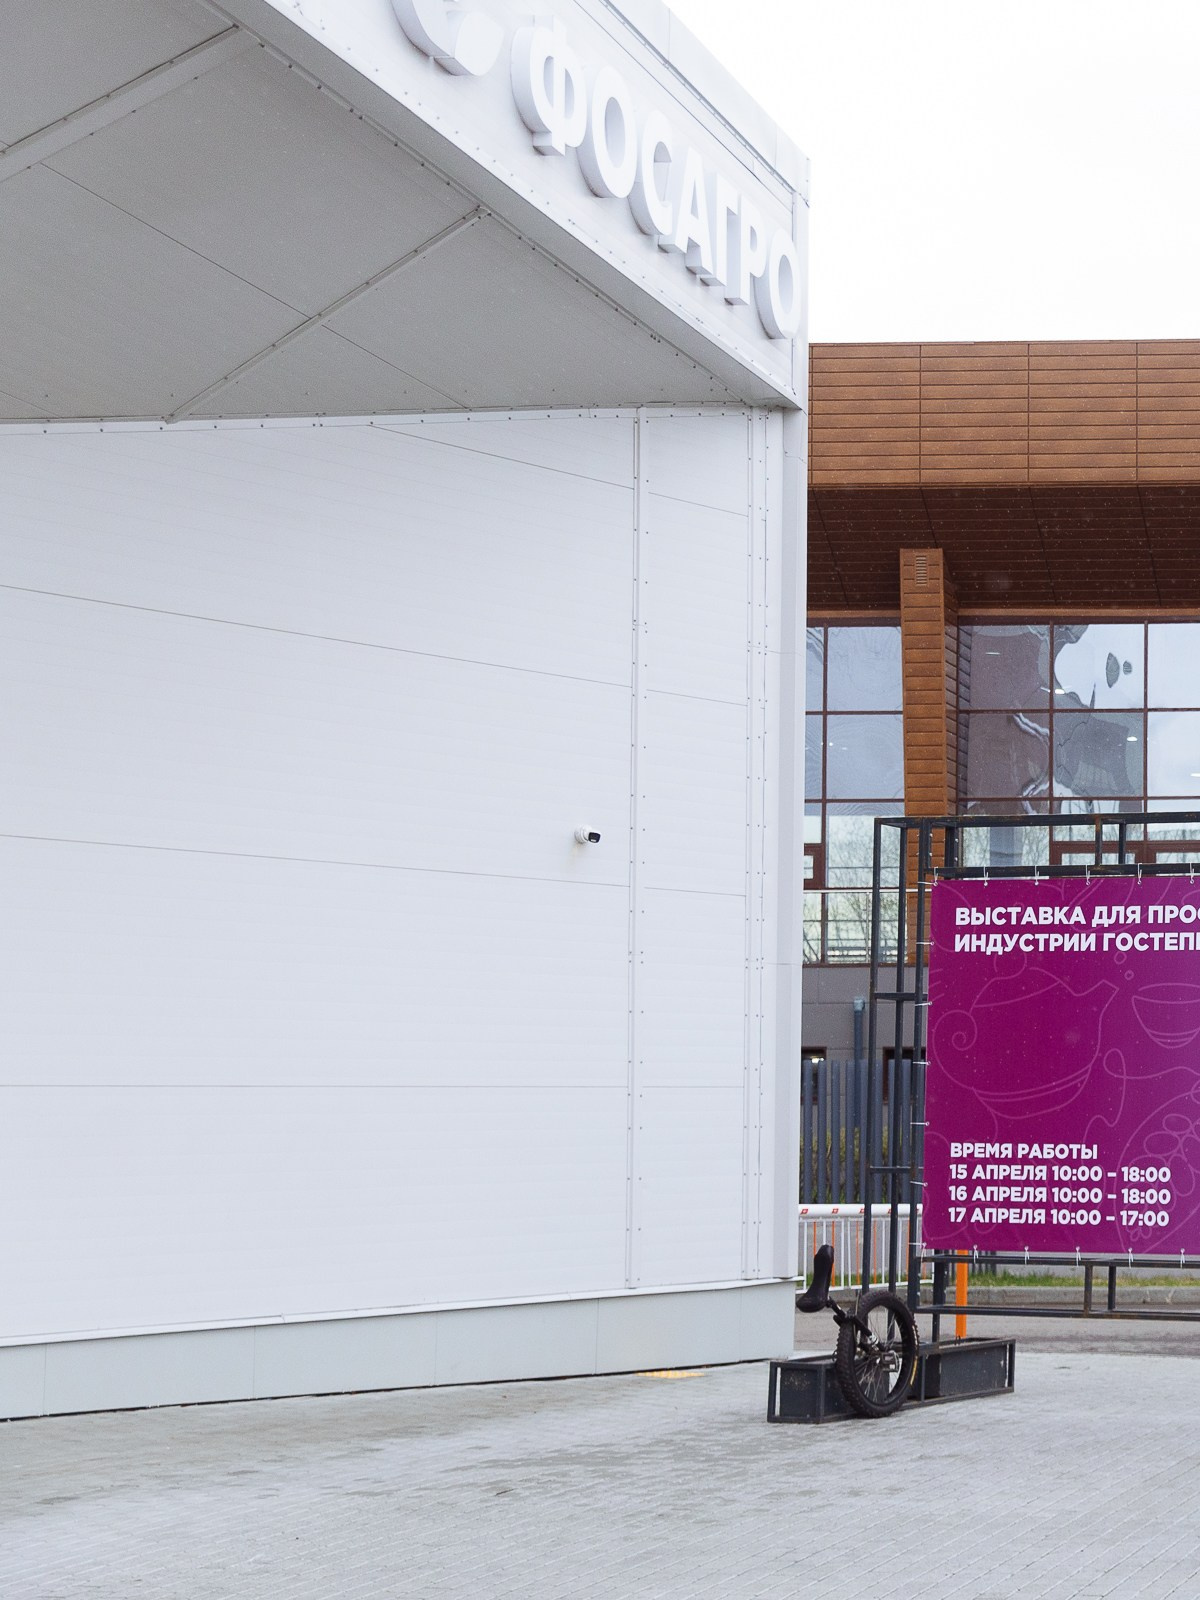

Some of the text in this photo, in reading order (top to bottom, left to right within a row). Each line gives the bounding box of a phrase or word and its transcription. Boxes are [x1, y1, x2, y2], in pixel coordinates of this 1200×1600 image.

[511, 14, 801, 339] ФОСАГРО
[955, 906, 1087, 926] ВЫСТАВКА
[1092, 906, 1141, 928] ДЛЯ
[954, 933, 1096, 955] ИНДУСТРИИ
[950, 1142, 1098, 1160] ВРЕМЯ РАБОТЫ
[949, 1164, 968, 1180] 15
[971, 1165, 1048, 1181] АПРЕЛЯ
[1051, 1166, 1103, 1182] 10:00
[1121, 1166, 1171, 1183] 18:00
[949, 1186, 968, 1201] 16
[971, 1186, 1047, 1203] АПРЕЛЯ
[1051, 1187, 1103, 1204] 10:00
[1121, 1188, 1171, 1205] 18:00
[948, 1207, 967, 1223] 17
[970, 1208, 1046, 1225] АПРЕЛЯ
[1050, 1209, 1102, 1226] 10:00
[1120, 1210, 1170, 1227] 17:00
